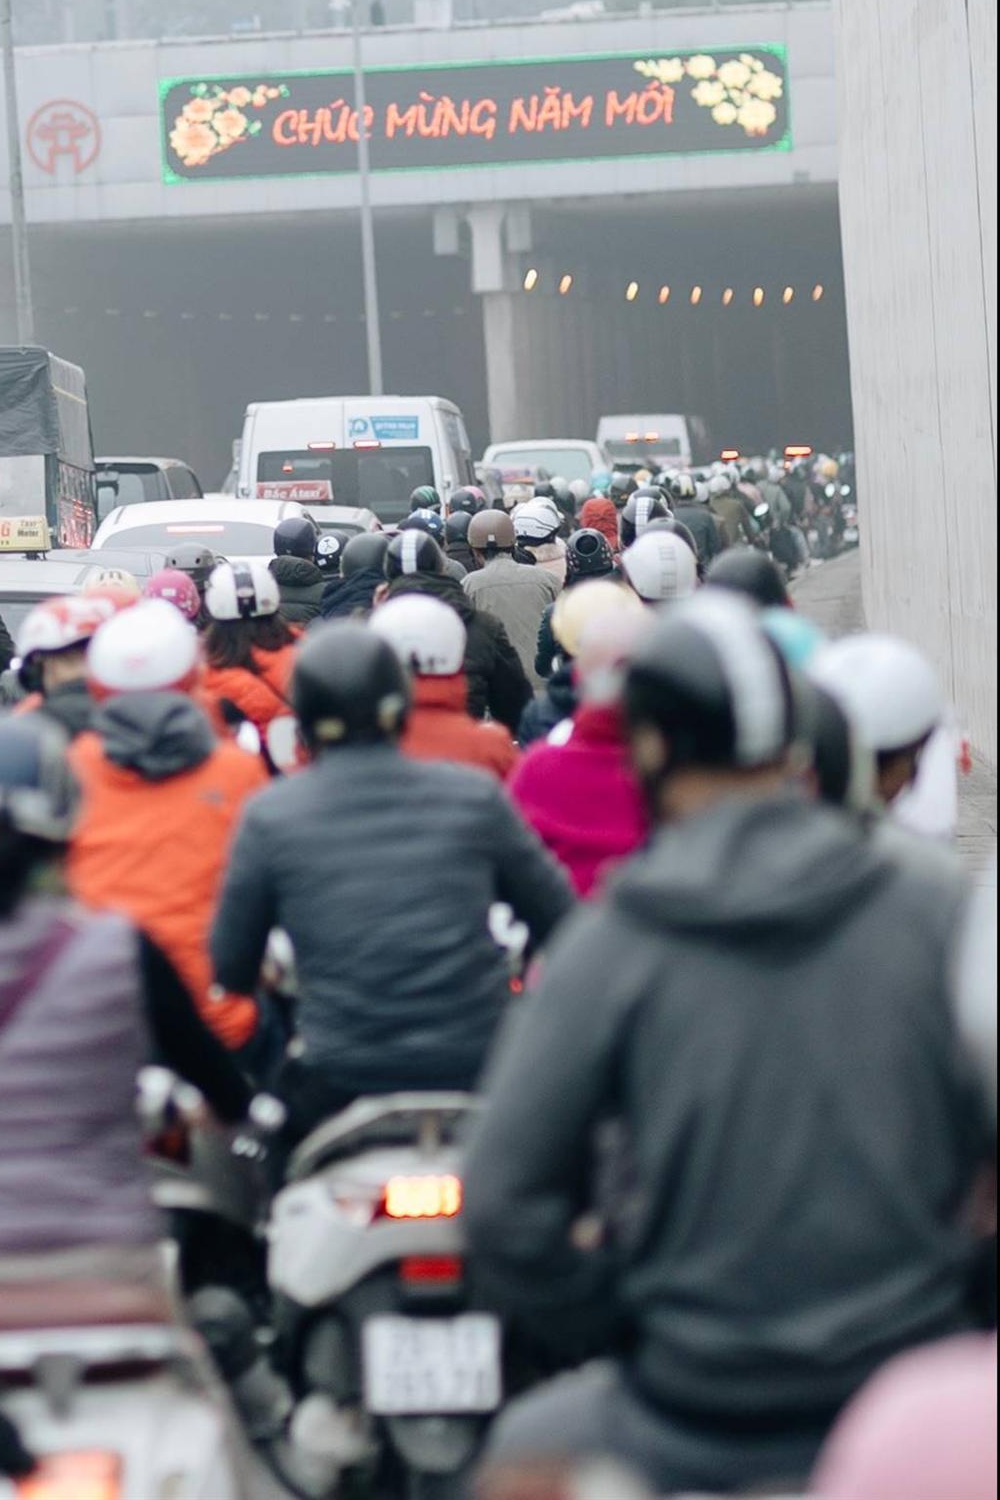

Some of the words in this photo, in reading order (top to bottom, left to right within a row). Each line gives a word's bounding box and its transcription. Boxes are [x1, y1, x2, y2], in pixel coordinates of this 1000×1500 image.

[272, 98, 374, 146] CHÚC
[385, 91, 497, 140] MỪNG
[508, 85, 594, 133] NĂM
[606, 80, 675, 127] MỚI
